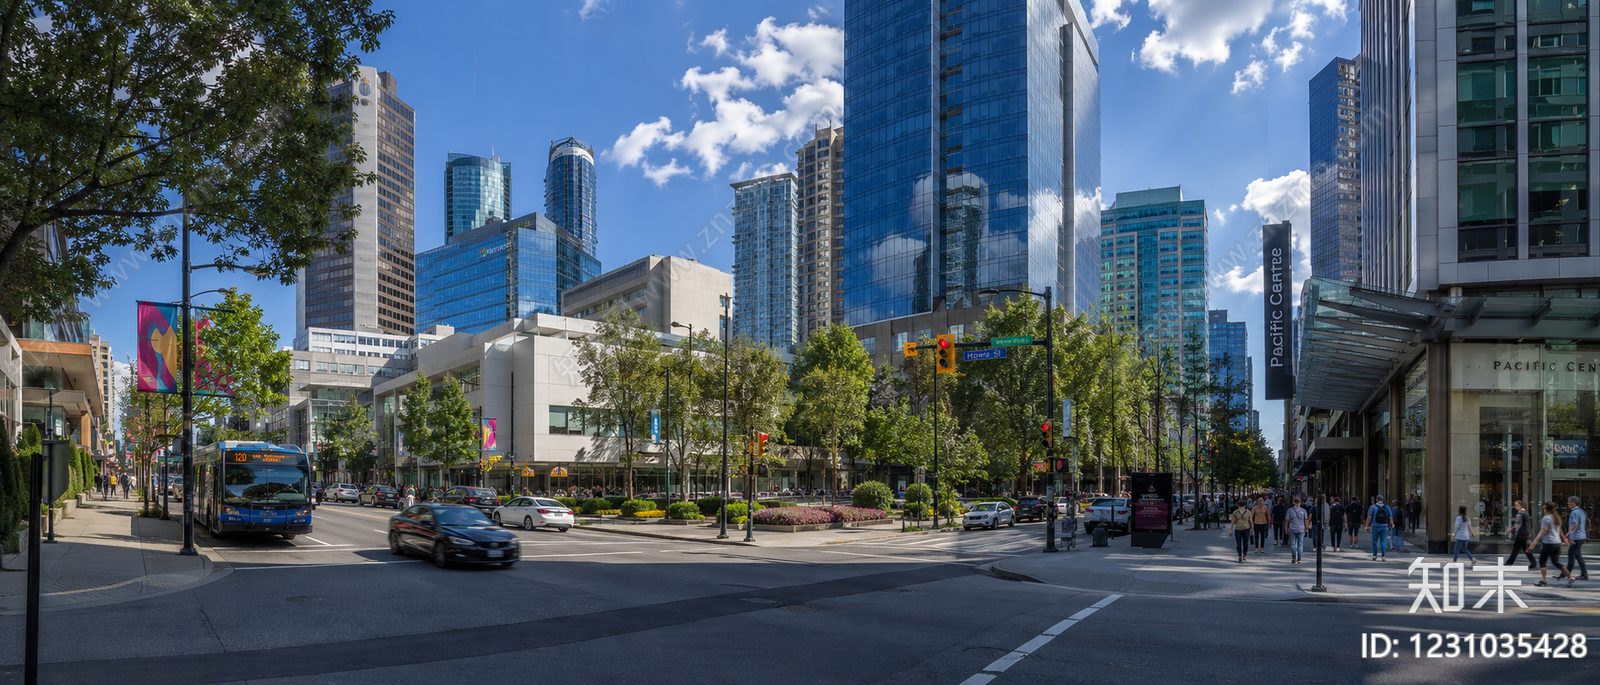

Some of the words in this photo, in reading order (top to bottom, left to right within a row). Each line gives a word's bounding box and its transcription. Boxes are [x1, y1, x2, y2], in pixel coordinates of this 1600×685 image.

[1493, 360, 1557, 371] PACIFIC
[1566, 361, 1600, 372] CEN
[234, 452, 247, 462] 120
